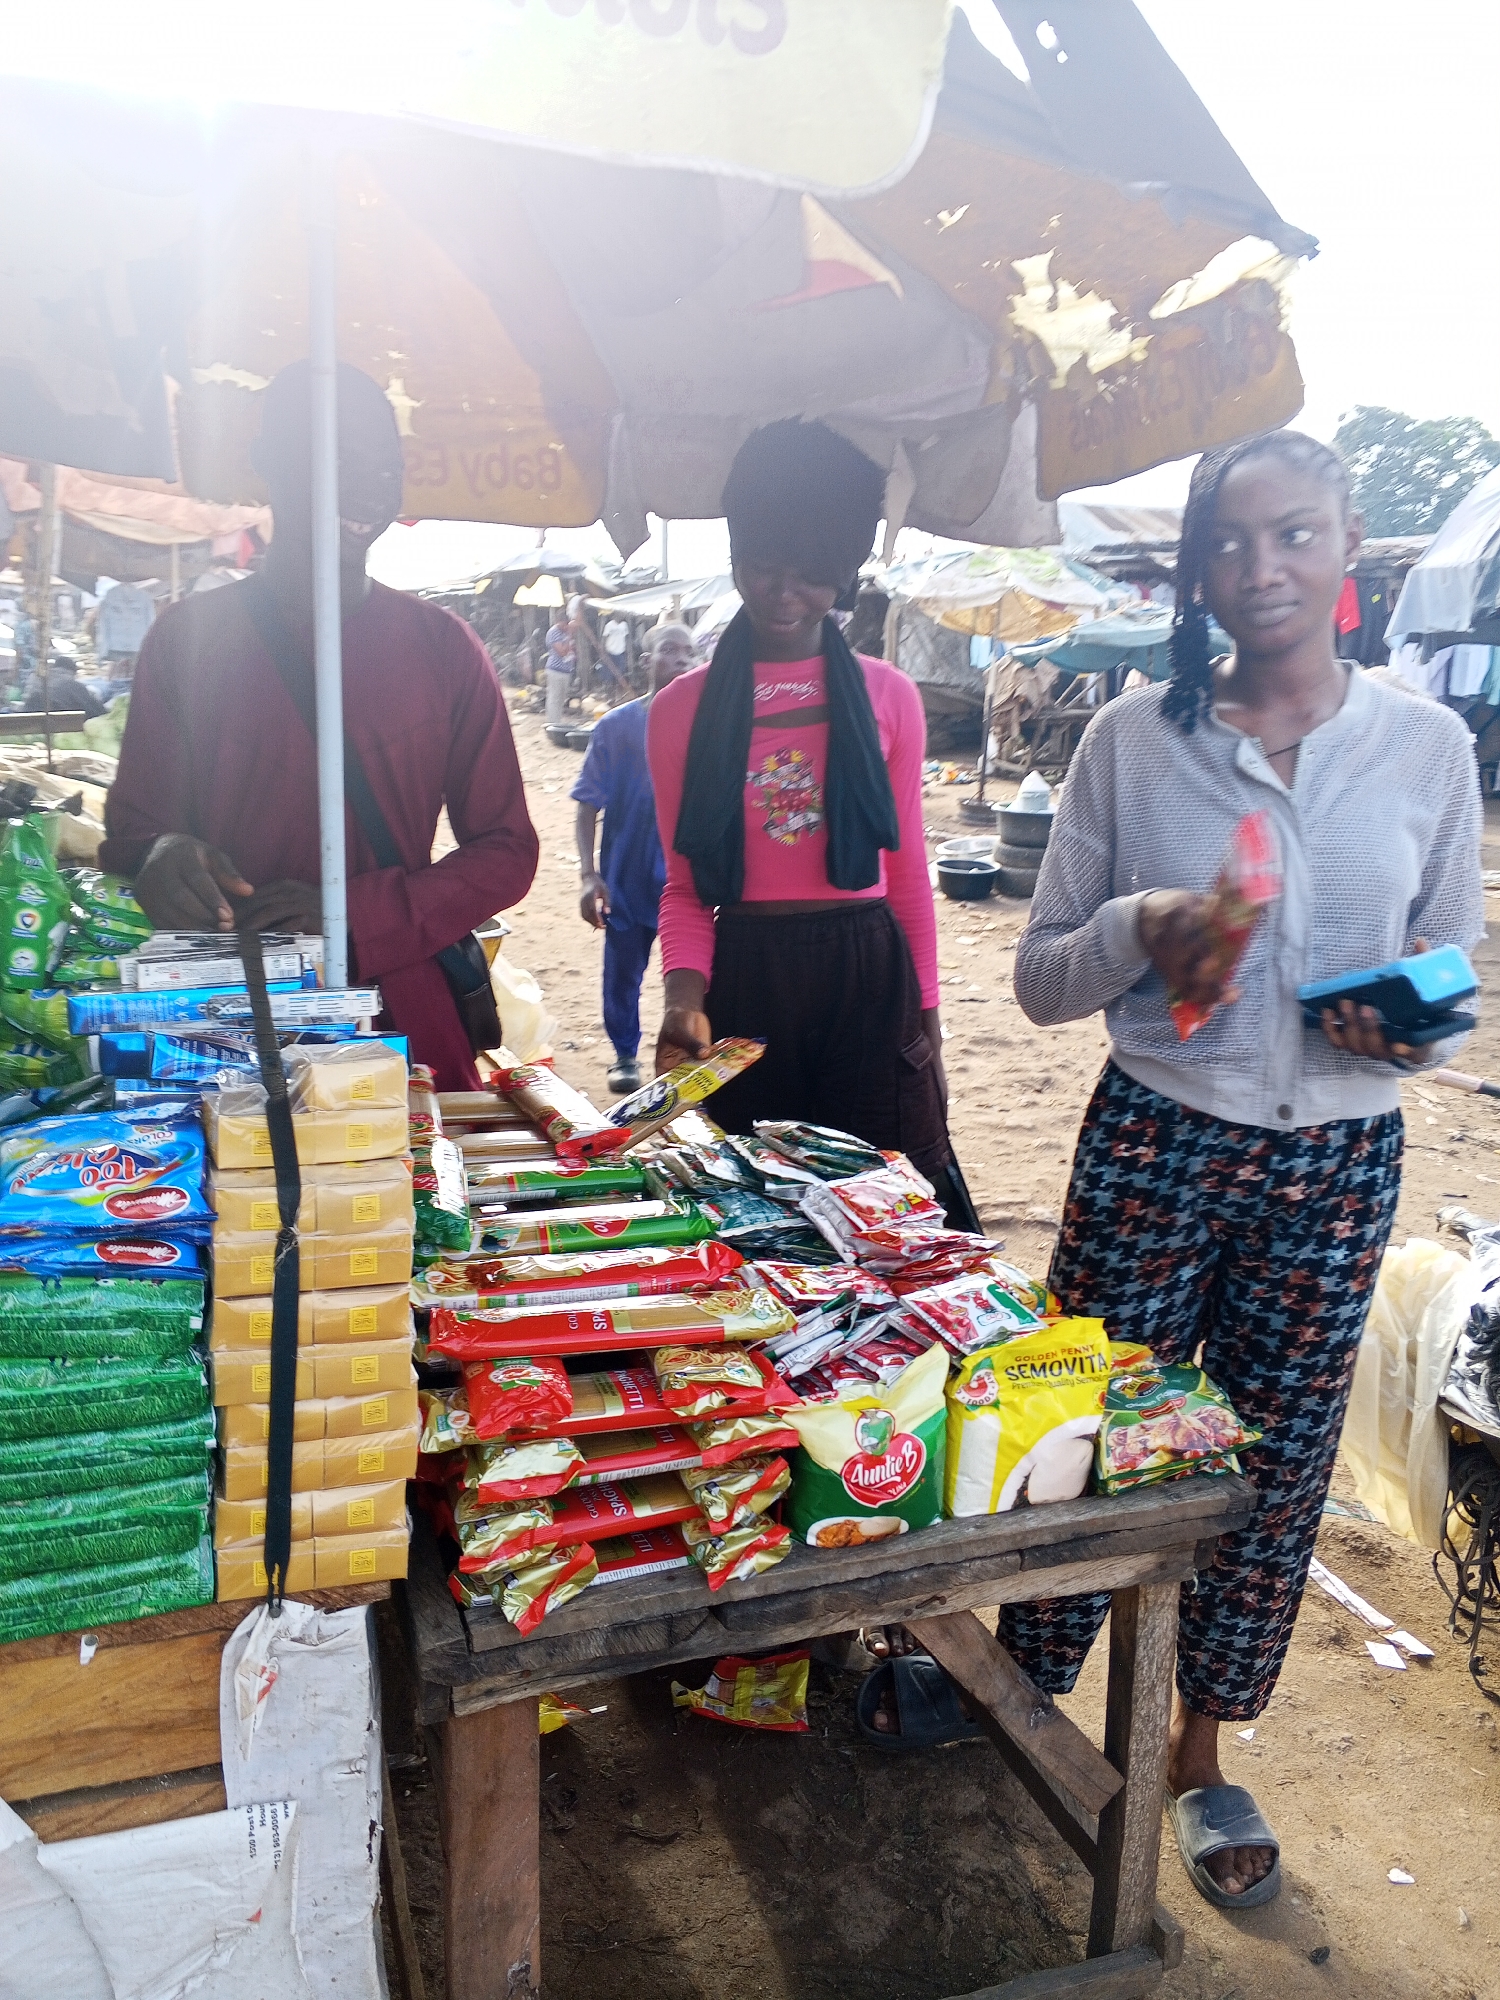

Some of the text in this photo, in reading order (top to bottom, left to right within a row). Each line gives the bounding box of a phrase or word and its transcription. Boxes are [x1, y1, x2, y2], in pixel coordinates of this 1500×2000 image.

[1005, 1352, 1109, 1382] SEMOVITA
[1015, 1344, 1094, 1362] GOLDEN PENNY
[850, 1454, 904, 1488] Auntie
